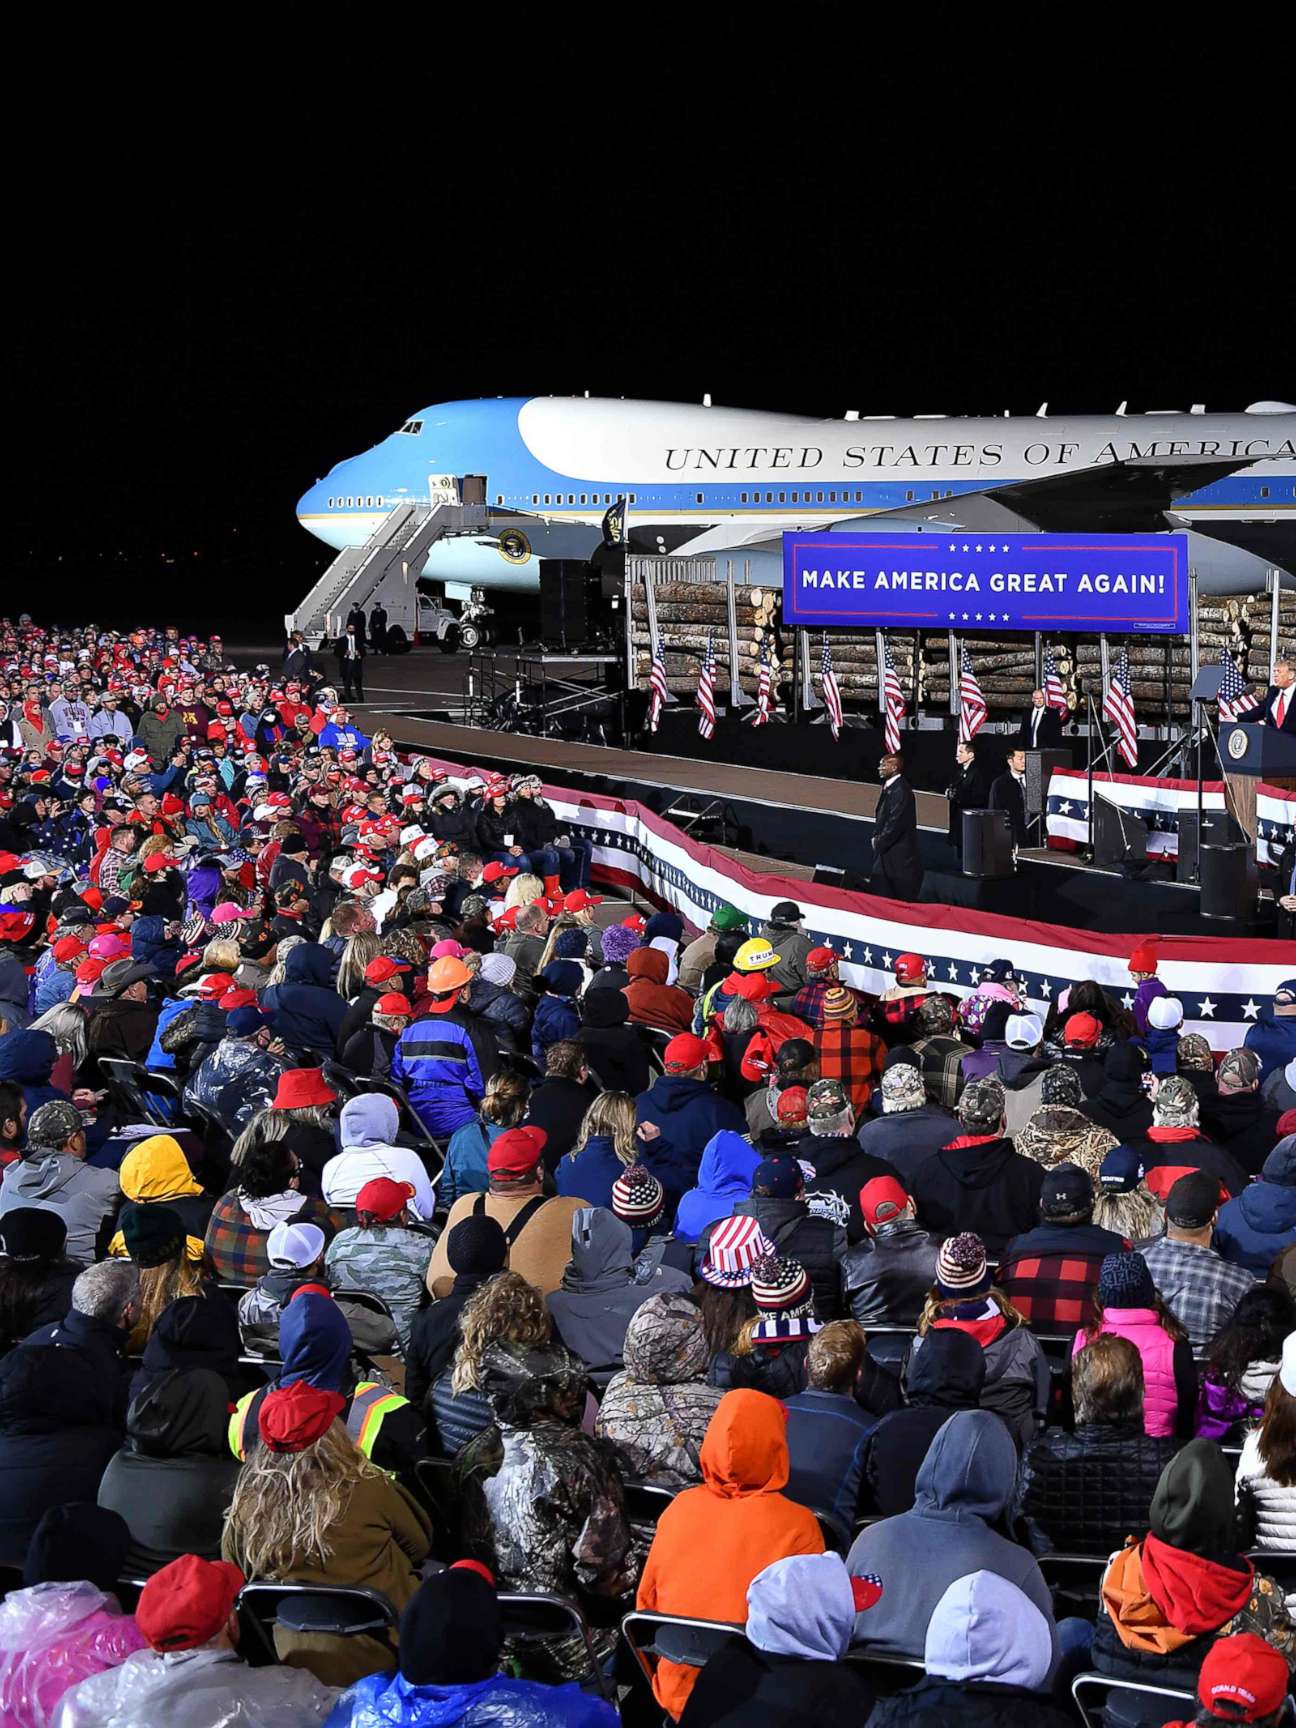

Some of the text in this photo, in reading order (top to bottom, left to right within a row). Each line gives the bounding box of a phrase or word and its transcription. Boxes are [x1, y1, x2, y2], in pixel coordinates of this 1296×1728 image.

[665, 447, 823, 470] UNITED
[842, 444, 1003, 469] STATES
[1024, 443, 1080, 465] OF
[802, 570, 1165, 594] MAKE AMERICA GREAT AGAIN!
[750, 951, 773, 962] TRUM
